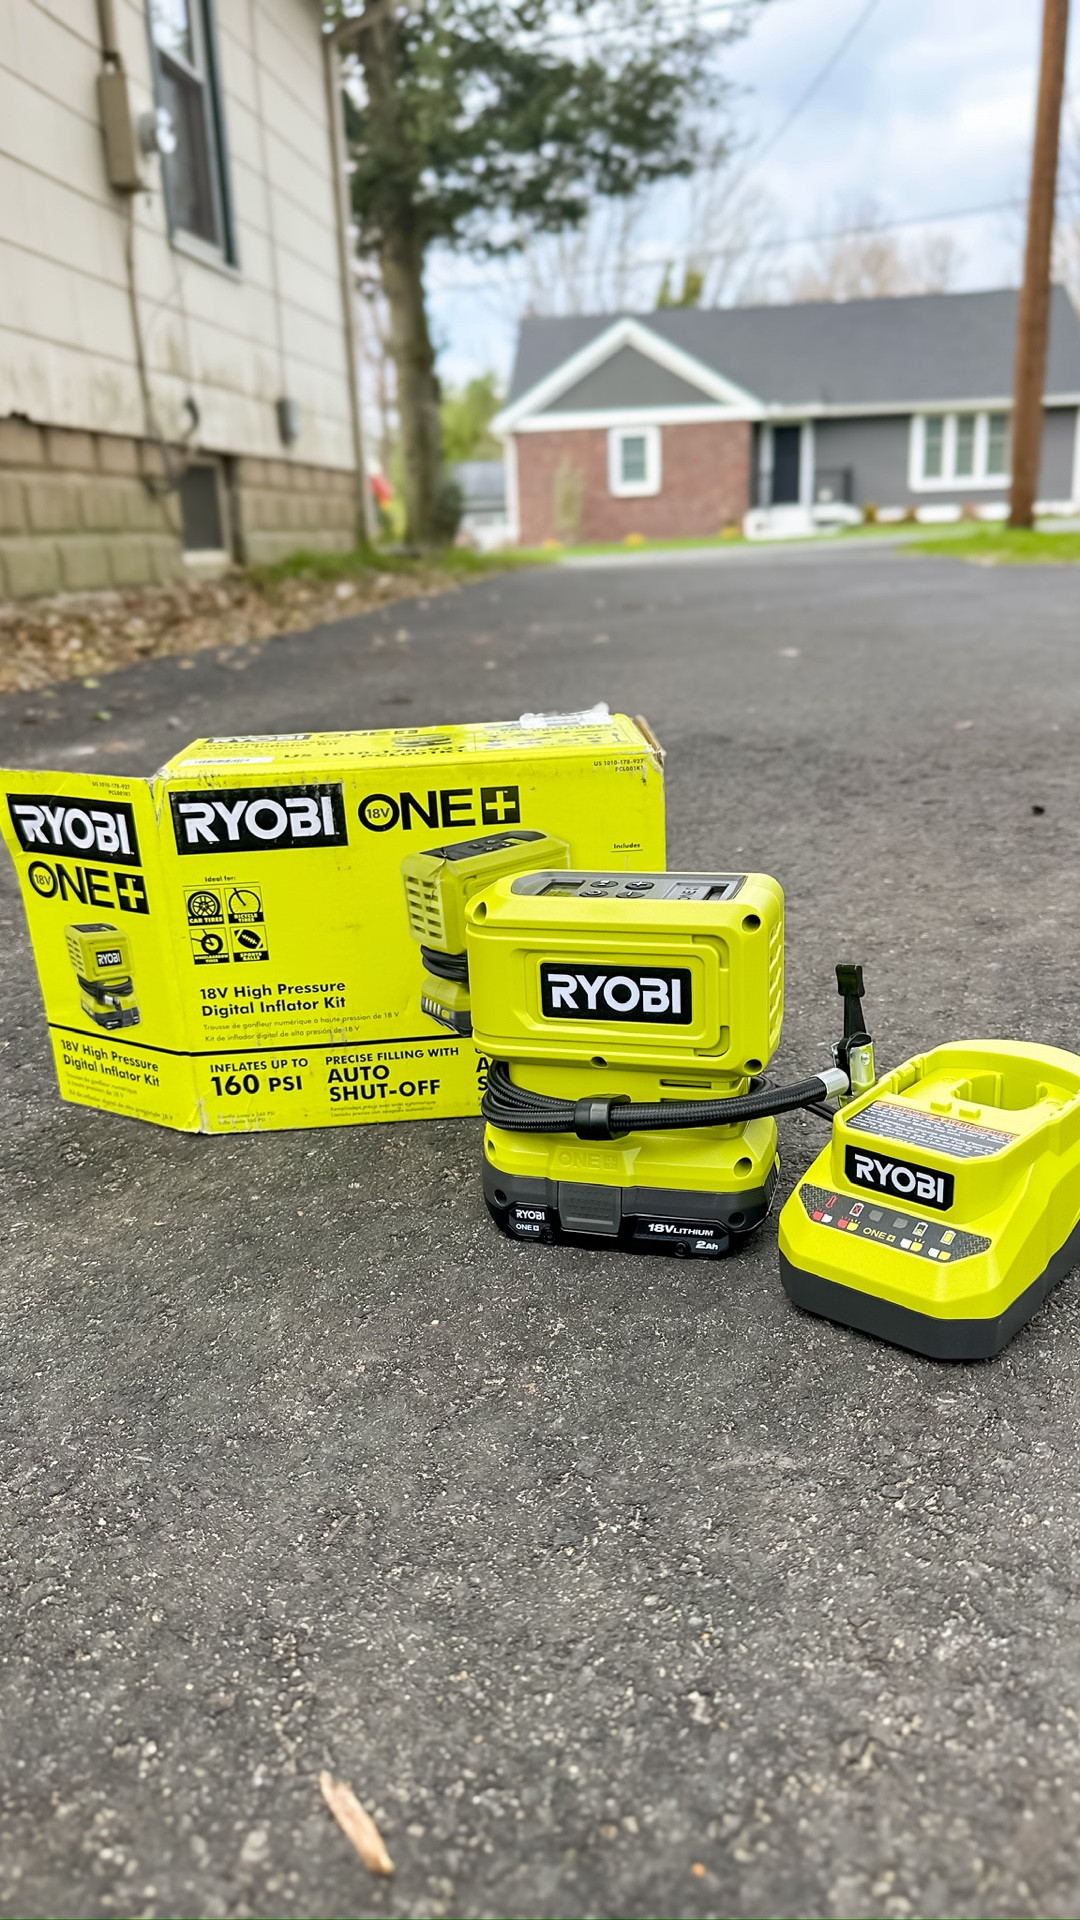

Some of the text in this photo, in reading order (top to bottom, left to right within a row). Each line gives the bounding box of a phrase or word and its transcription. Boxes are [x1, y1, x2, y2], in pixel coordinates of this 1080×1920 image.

[604, 758, 644, 766] 1010-178-927
[12, 804, 131, 854] RYOBI
[178, 796, 335, 844] RYOBI
[367, 808, 390, 819] 18V
[34, 874, 51, 886] 18V
[97, 953, 121, 965] RYOBI
[200, 982, 346, 1000] 18V High Pressure
[548, 974, 681, 1014] RYOBI
[202, 996, 346, 1018] Digital Inflator Kit
[243, 1020, 272, 1030] gonfleur
[274, 1018, 312, 1028] numérique
[342, 1014, 371, 1023] pression
[227, 1032, 255, 1040] inflador
[256, 1030, 278, 1040] digital
[306, 1027, 332, 1037] presión
[61, 1039, 158, 1072] 18V High Pressure
[326, 1047, 459, 1065] PRECISE FILLING WITH
[64, 1054, 98, 1072] Digital
[101, 1064, 141, 1082] Inflator
[144, 1073, 160, 1087] Kit
[210, 1058, 308, 1073] INFLATES UP TO
[328, 1065, 390, 1083] AUTO
[211, 1074, 302, 1096] 160 PSI
[330, 1080, 440, 1102] SHUT-OFF
[854, 1154, 944, 1204] RYOBI
[516, 1209, 545, 1221] RYOBI
[695, 1240, 718, 1250] 2Ah
